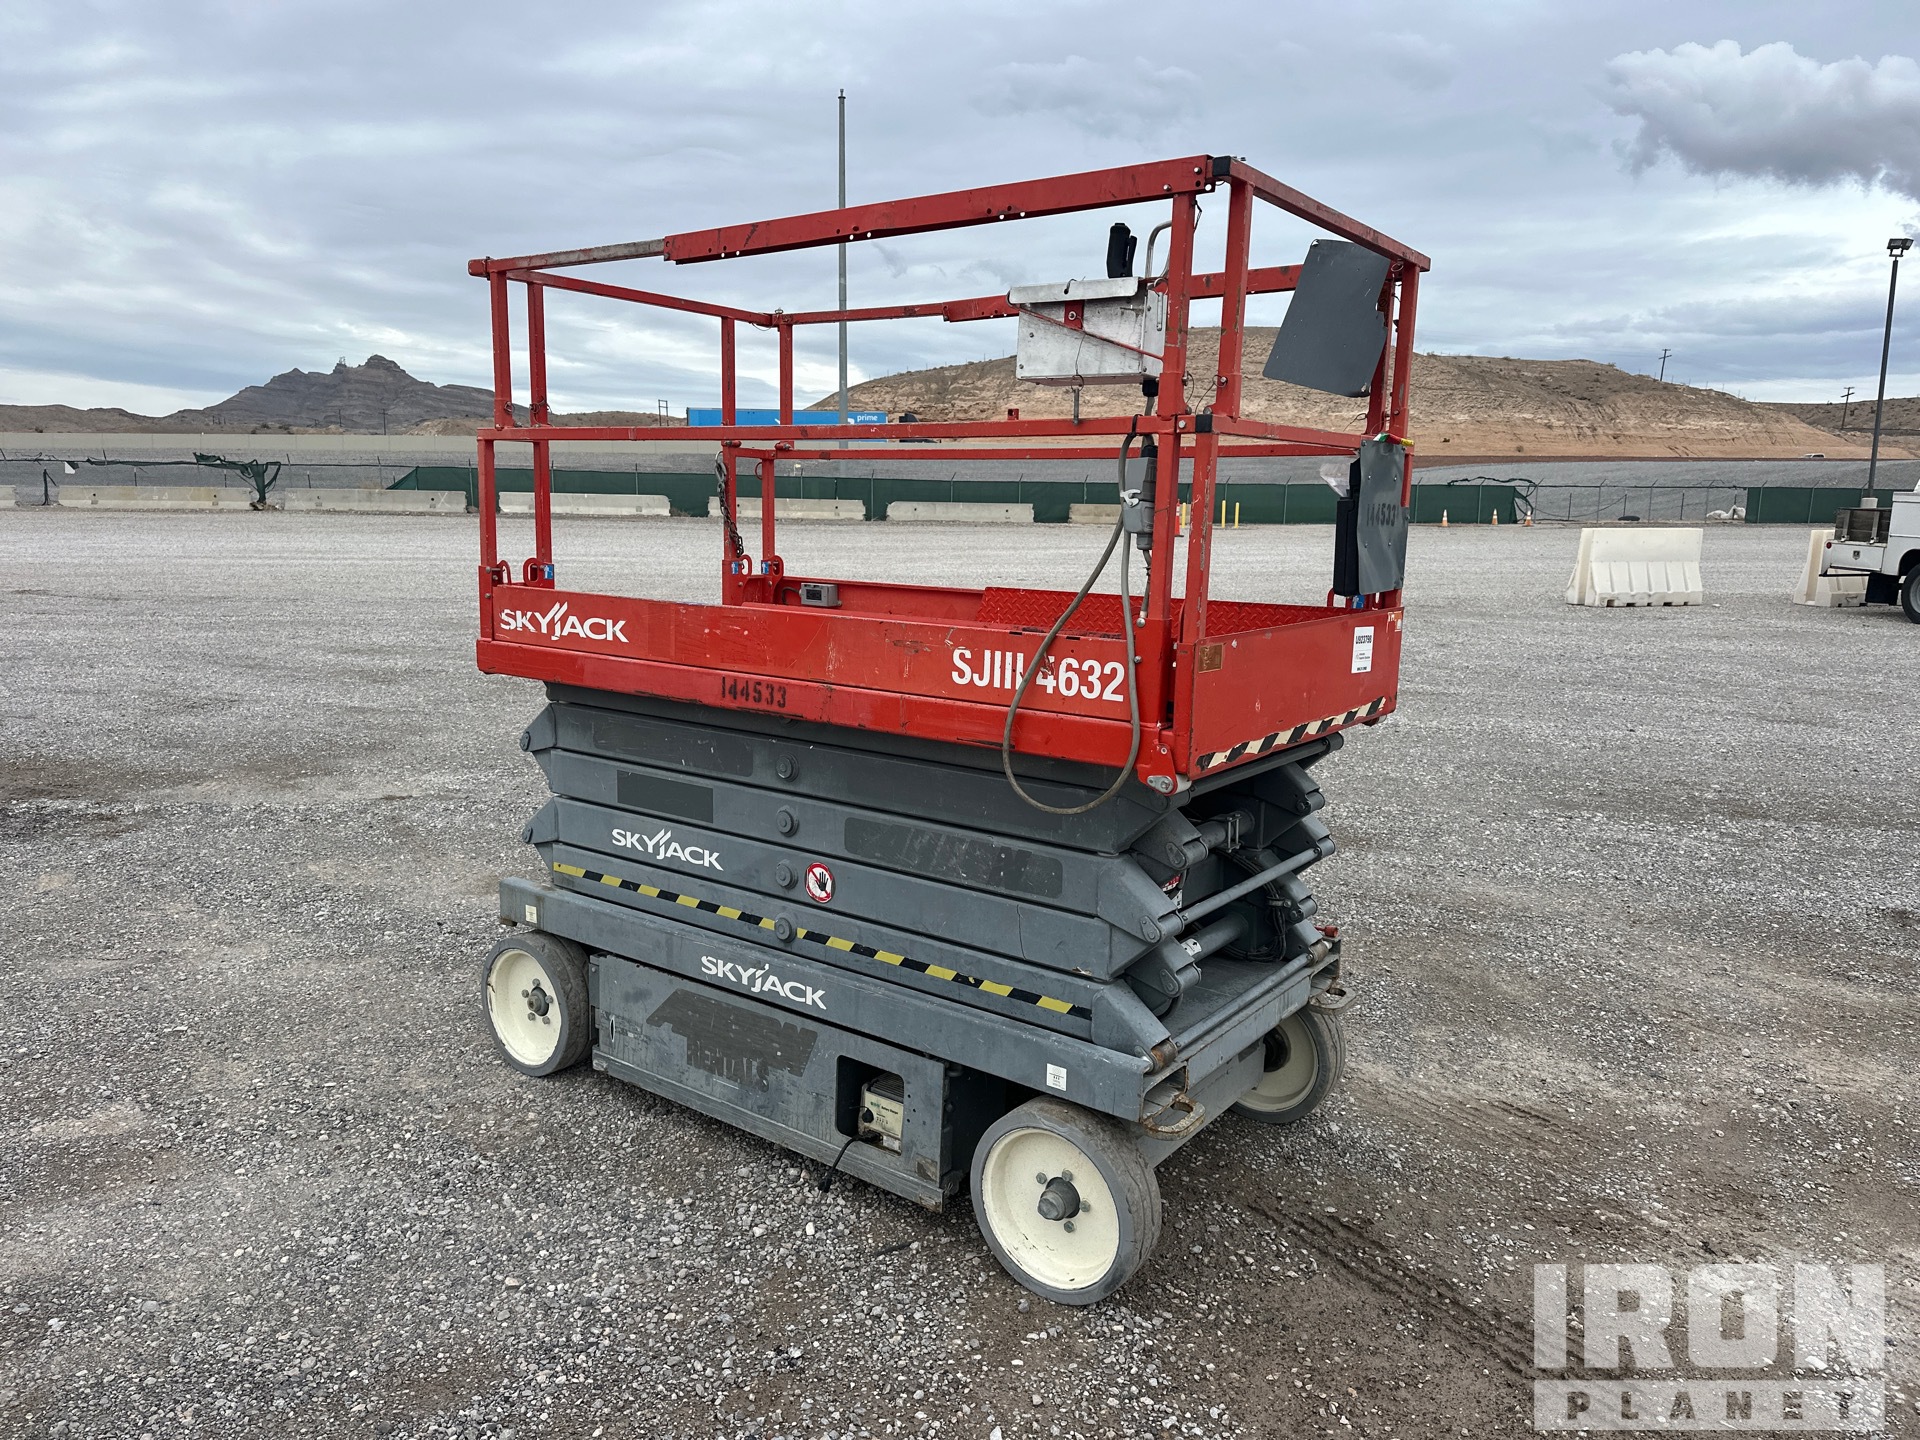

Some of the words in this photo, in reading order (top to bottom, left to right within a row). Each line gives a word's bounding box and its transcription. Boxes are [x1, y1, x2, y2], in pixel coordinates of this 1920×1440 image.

[857, 414, 878, 422] prime
[500, 601, 629, 643] SKYJACK
[721, 676, 786, 708] 144533
[951, 646, 1024, 690] SJIII
[1035, 655, 1125, 702] 4632
[611, 828, 723, 871] SKYJACK
[701, 955, 827, 1010] SKYJACK
